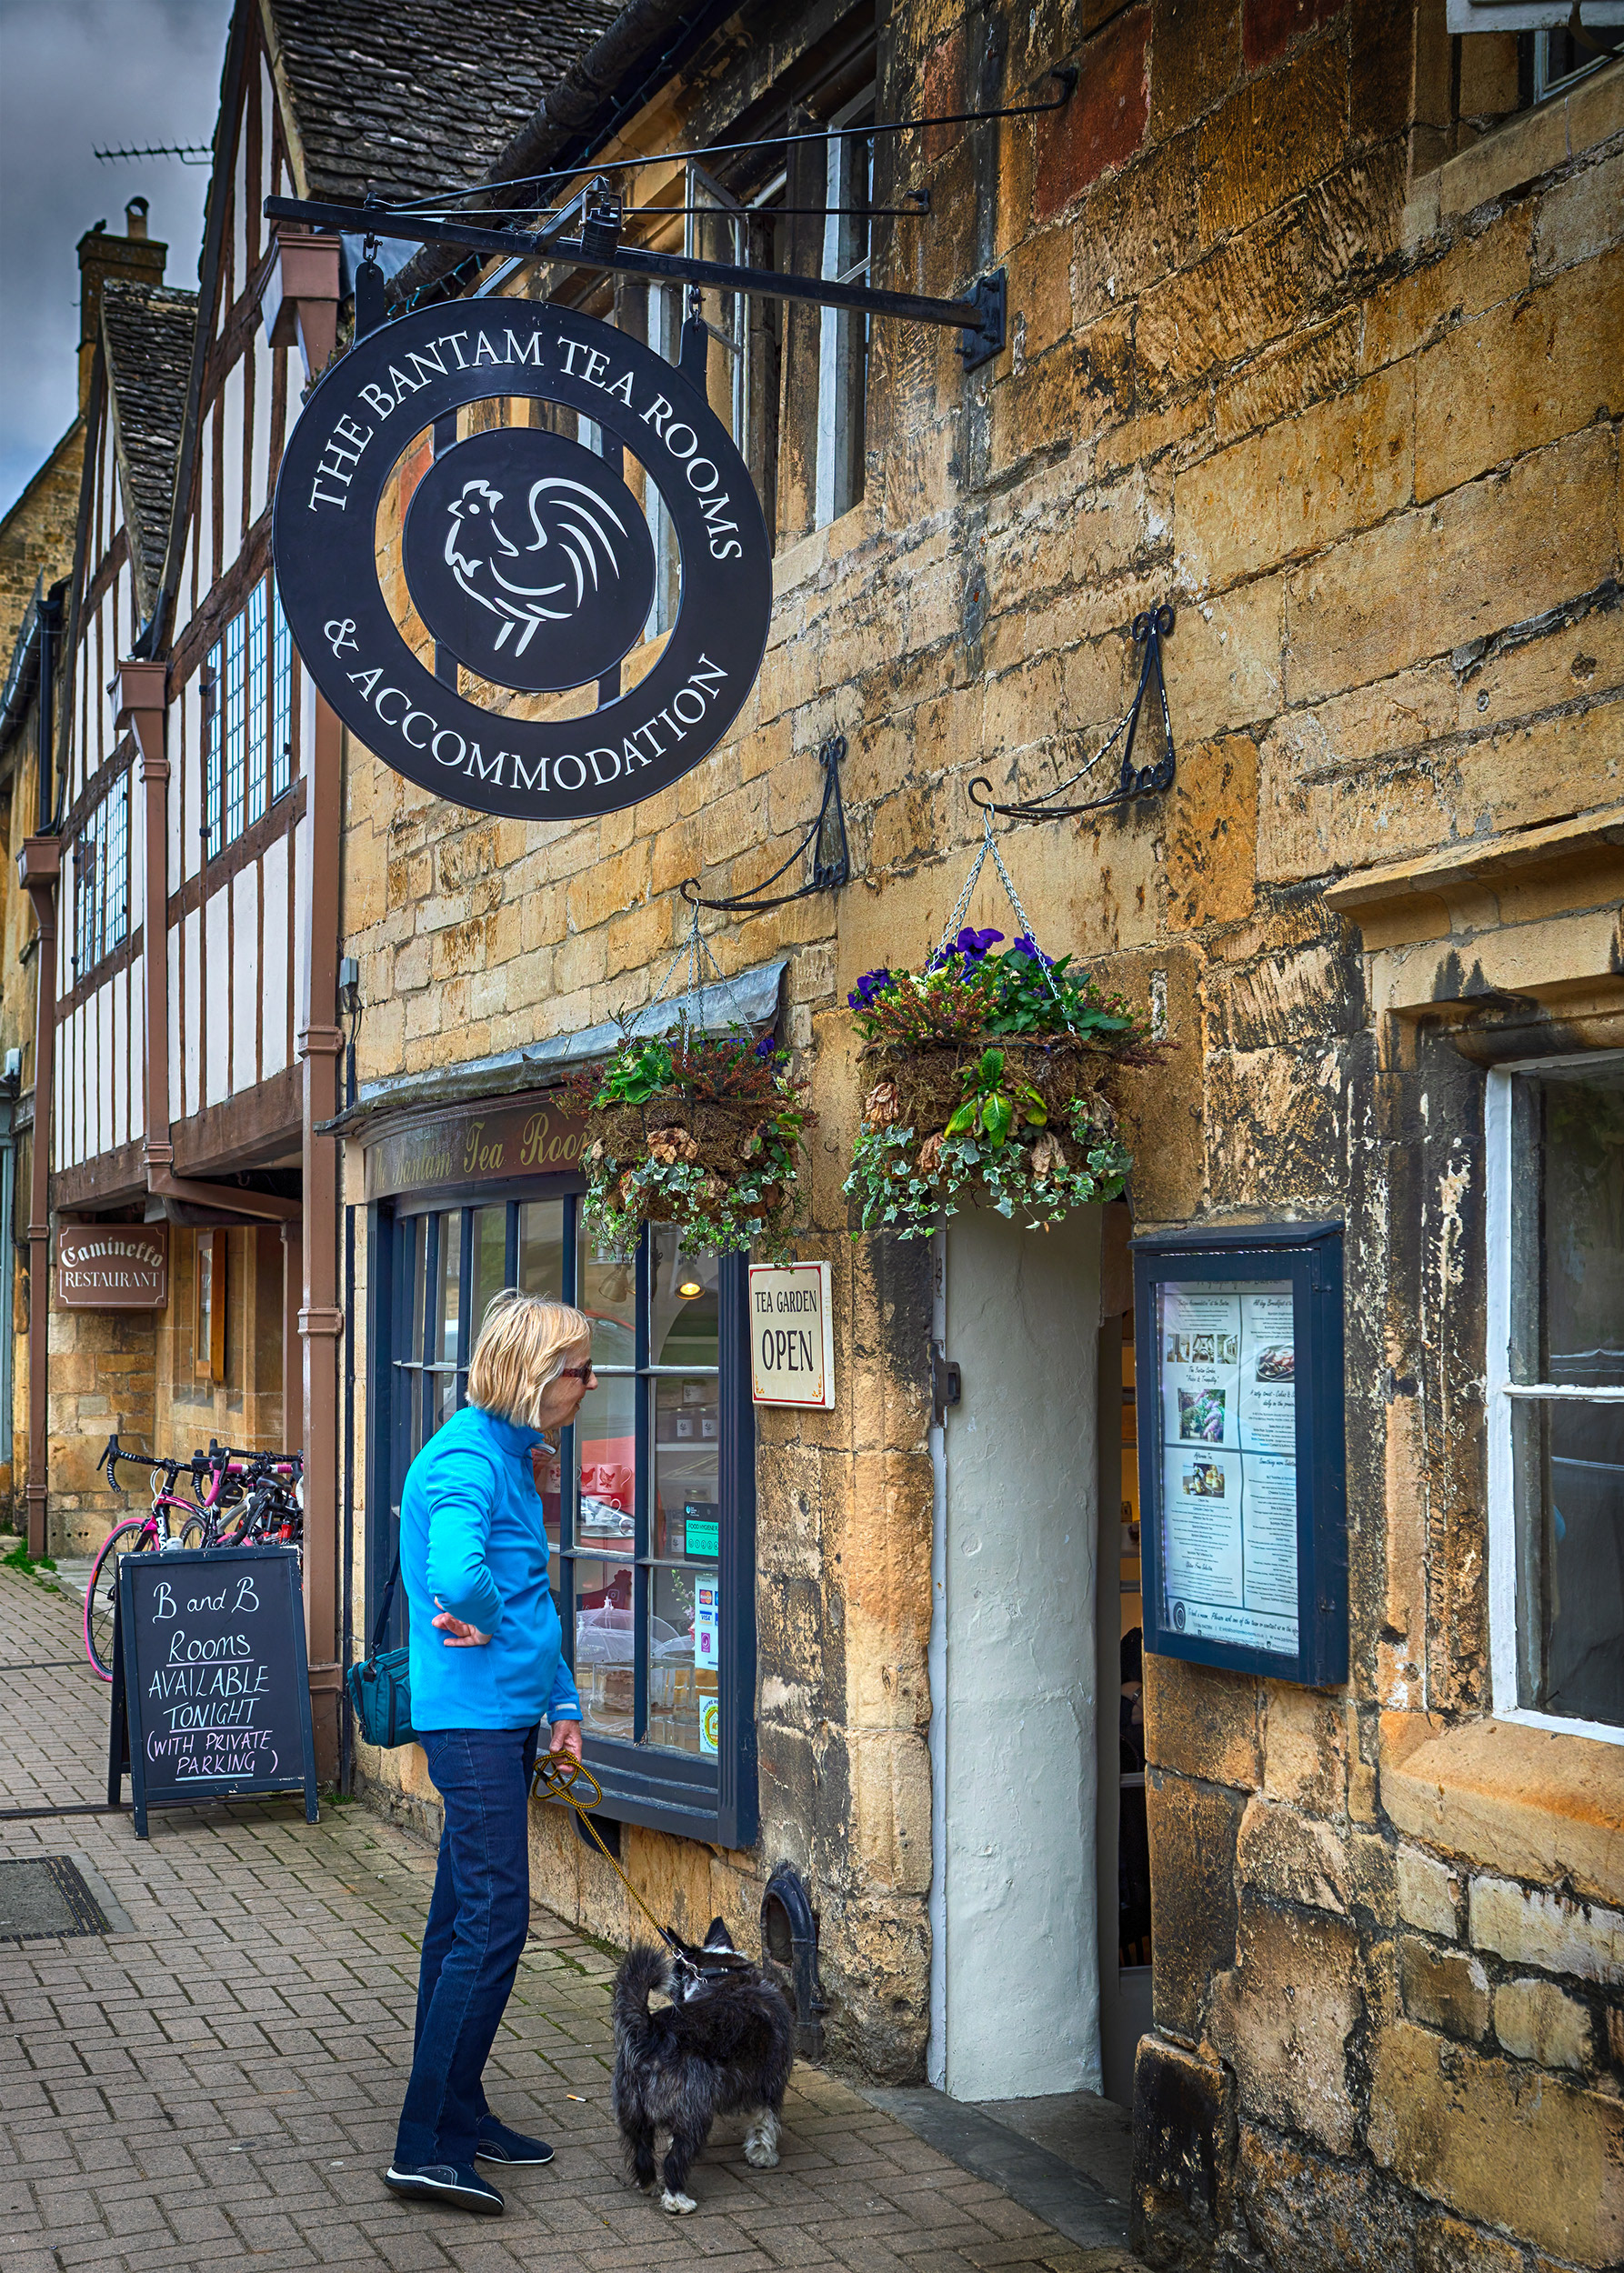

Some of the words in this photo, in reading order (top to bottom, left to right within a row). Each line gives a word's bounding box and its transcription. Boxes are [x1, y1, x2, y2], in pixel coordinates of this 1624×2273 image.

[308, 415, 374, 512] THE
[358, 329, 544, 422] BANTAM
[557, 336, 634, 406] TEA
[639, 394, 743, 561] ROOMS
[324, 618, 360, 658] &
[346, 654, 728, 791] ACCOMMODATION
[393, 1140, 452, 1186] Bantam
[464, 1122, 504, 1173] Tea
[61, 1237, 164, 1267] Caminetto
[65, 1271, 160, 1288] RESTAURANT
[755, 1291, 774, 1313] TEA
[777, 1290, 817, 1313] GARDEN
[762, 1328, 814, 1372] OPEN
[152, 1582, 177, 1624] B
[186, 1588, 226, 1613] and
[231, 1576, 260, 1613] B
[148, 1666, 270, 1699] AVAILABLE
[163, 1697, 261, 1729] TONIGHT
[206, 1730, 273, 1752] PRIVATE
[176, 1751, 256, 1775] PARKING
